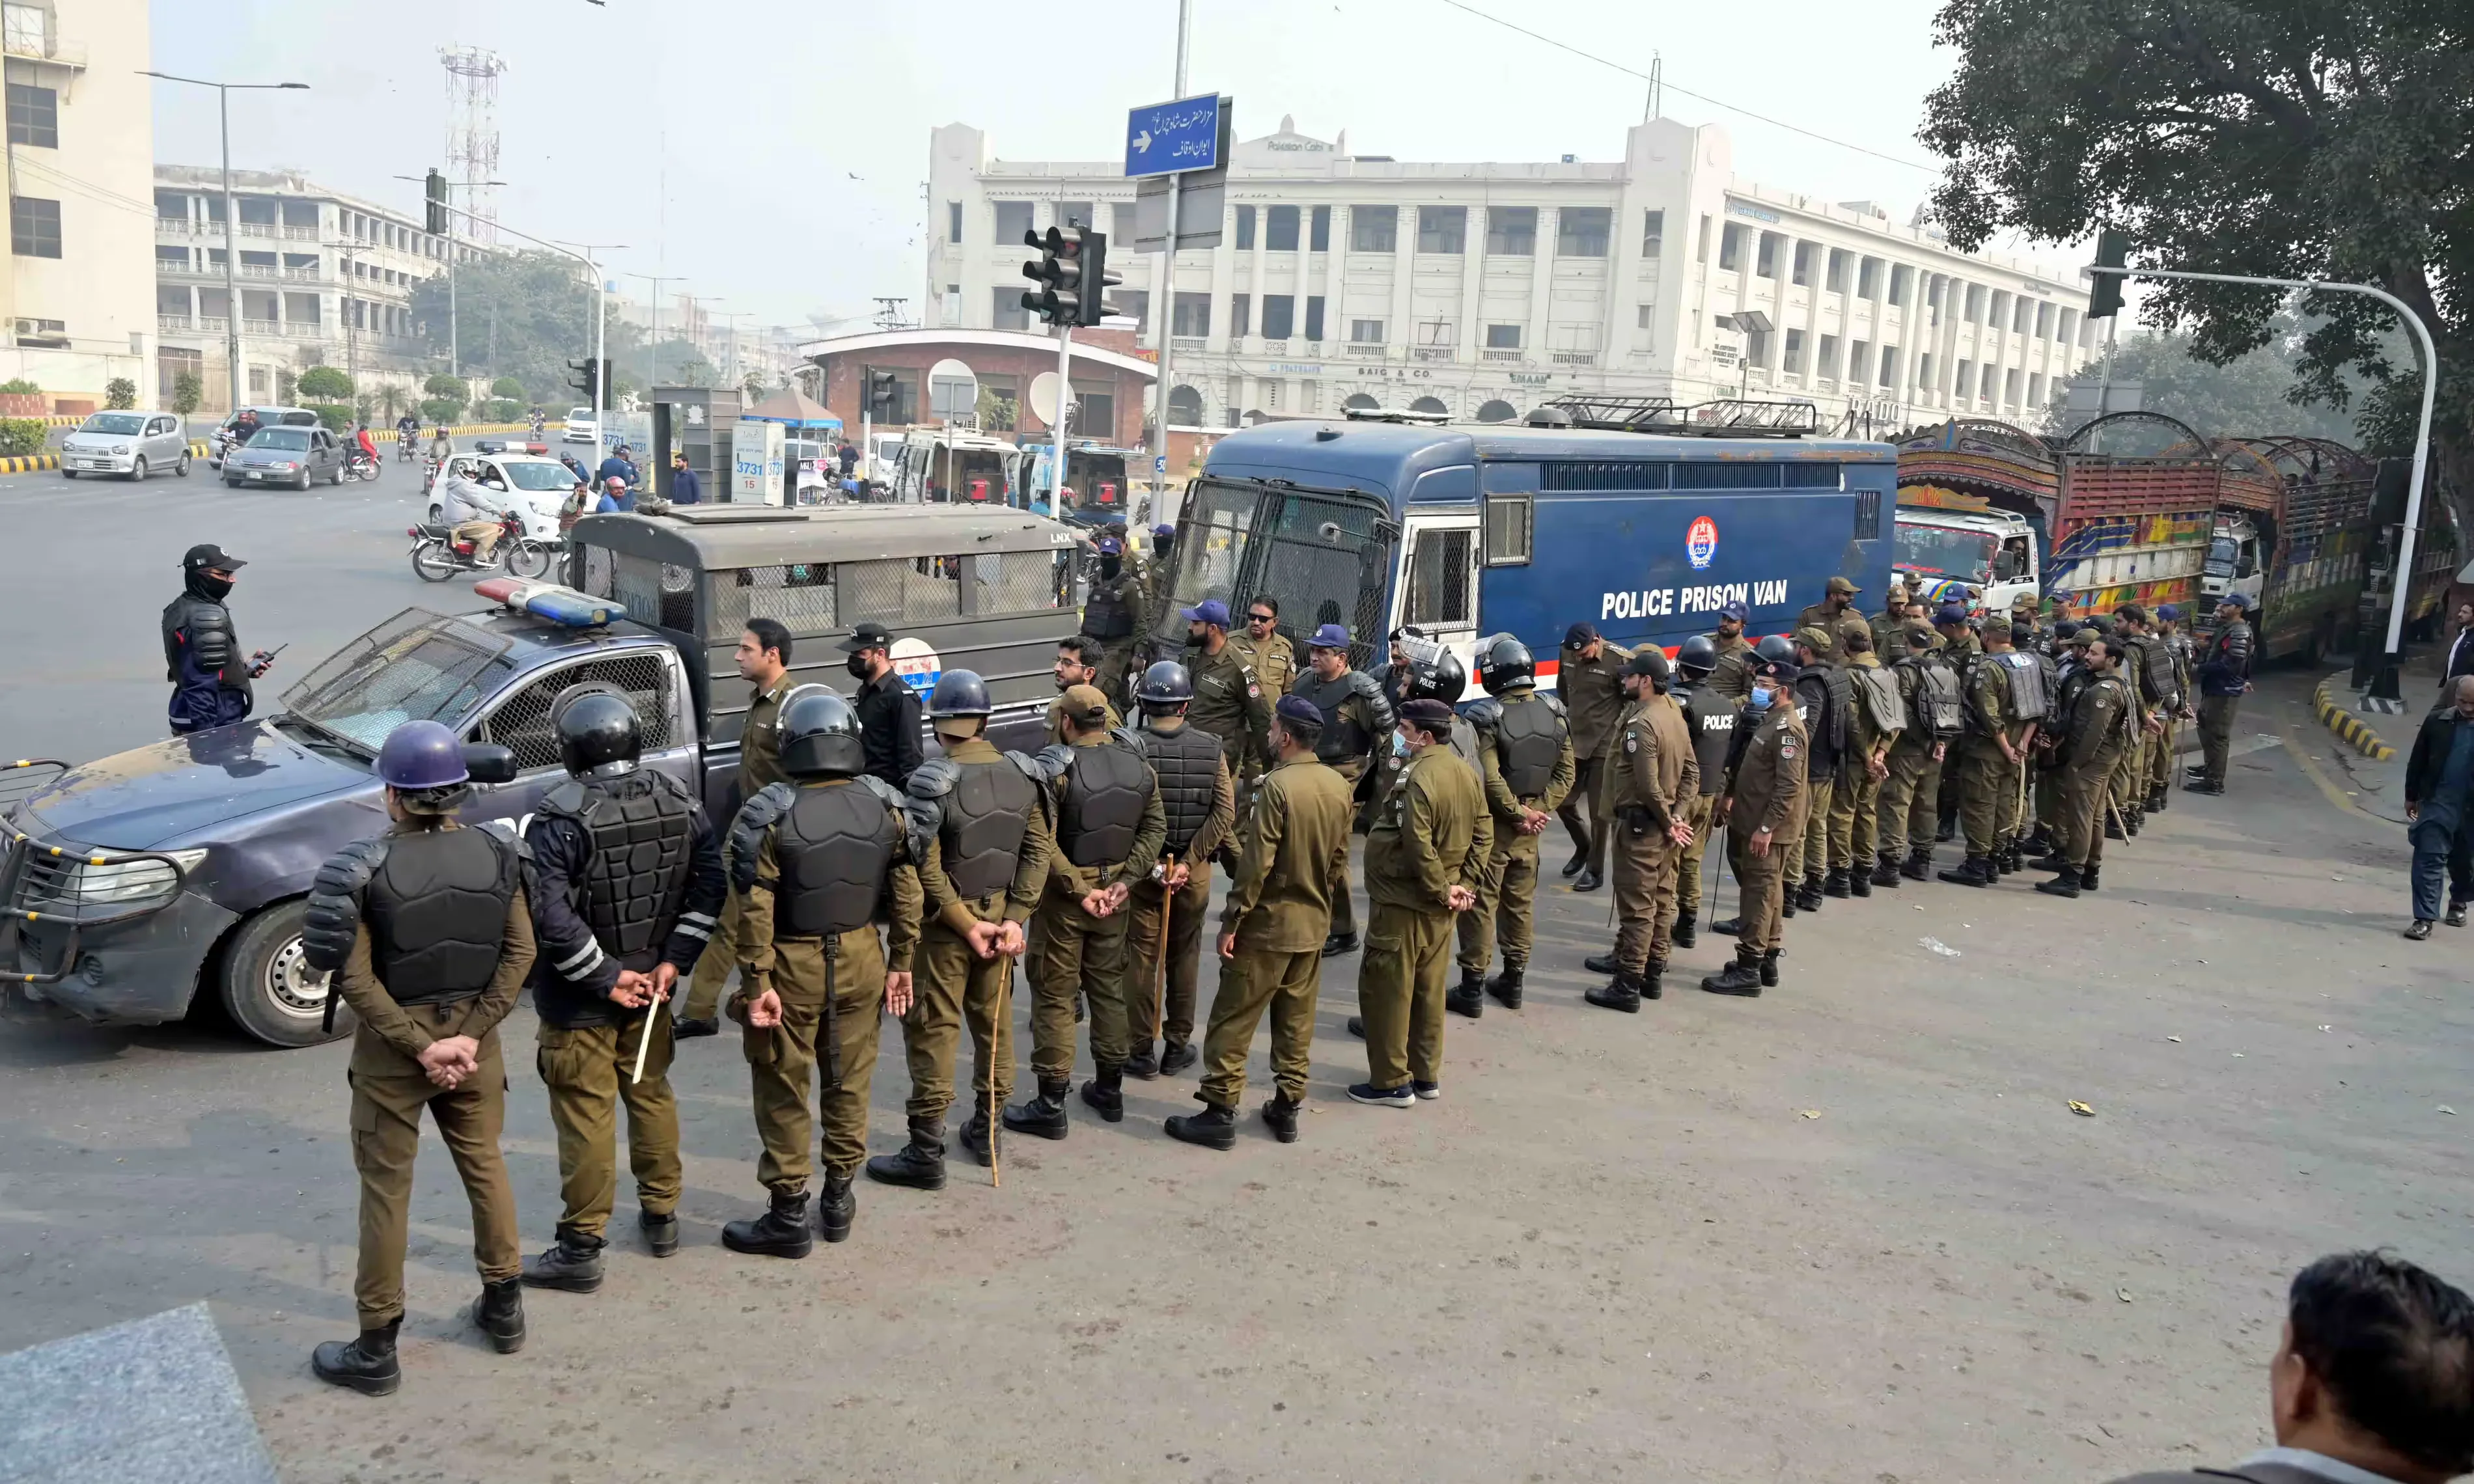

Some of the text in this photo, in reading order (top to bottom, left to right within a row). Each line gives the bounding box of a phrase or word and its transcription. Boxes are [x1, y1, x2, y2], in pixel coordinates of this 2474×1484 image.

[1358, 367, 1387, 376] BAIG
[1851, 398, 1902, 422] RADO
[604, 433, 624, 447] 3731
[737, 461, 762, 476] 3731
[768, 462, 783, 476] 3731
[745, 480, 755, 489] 15
[1050, 532, 1072, 543] LNX
[1601, 579, 1787, 620] POLICE PRISON VAN
[1147, 681, 1171, 693] POLICE
[1419, 677, 1437, 689] POLICE
[1703, 714, 1734, 730] POLICE
